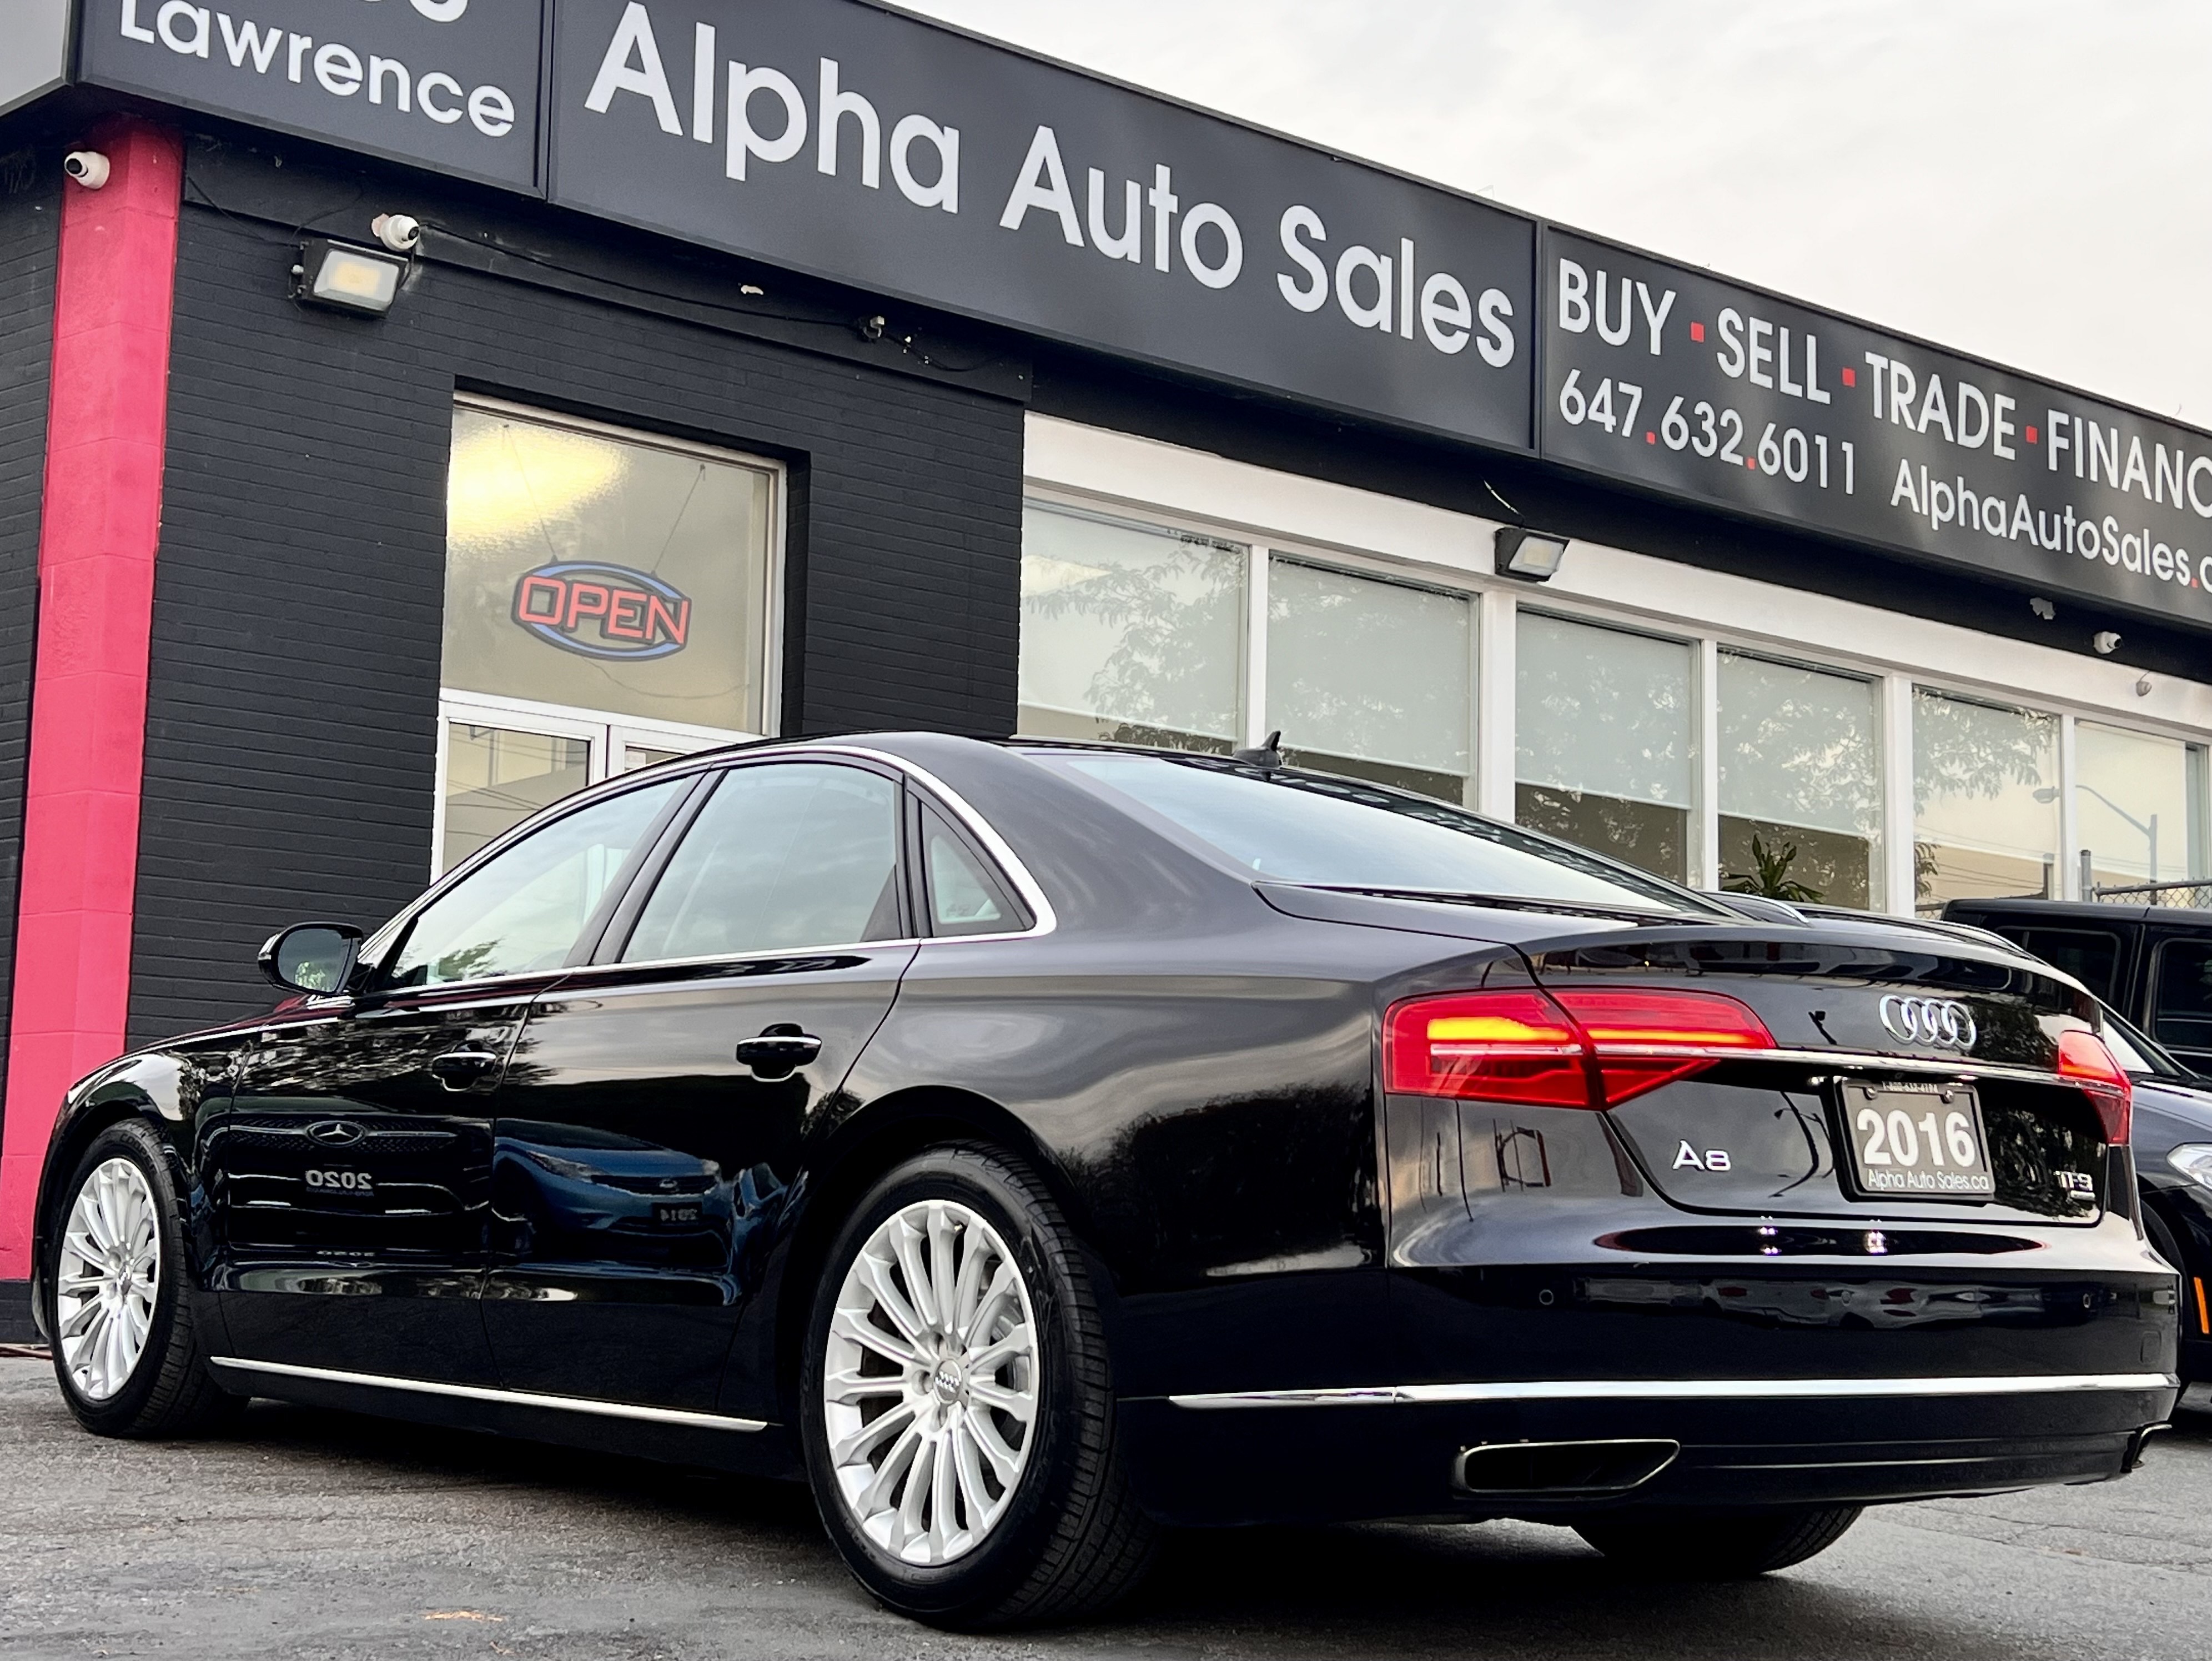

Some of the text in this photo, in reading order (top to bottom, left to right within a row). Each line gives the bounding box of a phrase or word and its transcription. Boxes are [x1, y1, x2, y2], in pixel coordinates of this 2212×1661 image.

[120, 0, 515, 137] Lawrence
[584, 1, 1514, 368] Alpha Auto Sales
[1559, 258, 1676, 355] BUY
[1717, 308, 1831, 404] SELL
[1865, 351, 2015, 460] TRADE
[1560, 369, 1853, 494] 647.632.6011
[517, 575, 691, 645] OPEN
[1672, 1140, 1731, 1171] A8
[1857, 1108, 1975, 1167] 2016
[1868, 1168, 1990, 1191] Alpha Auto Sales.ca
